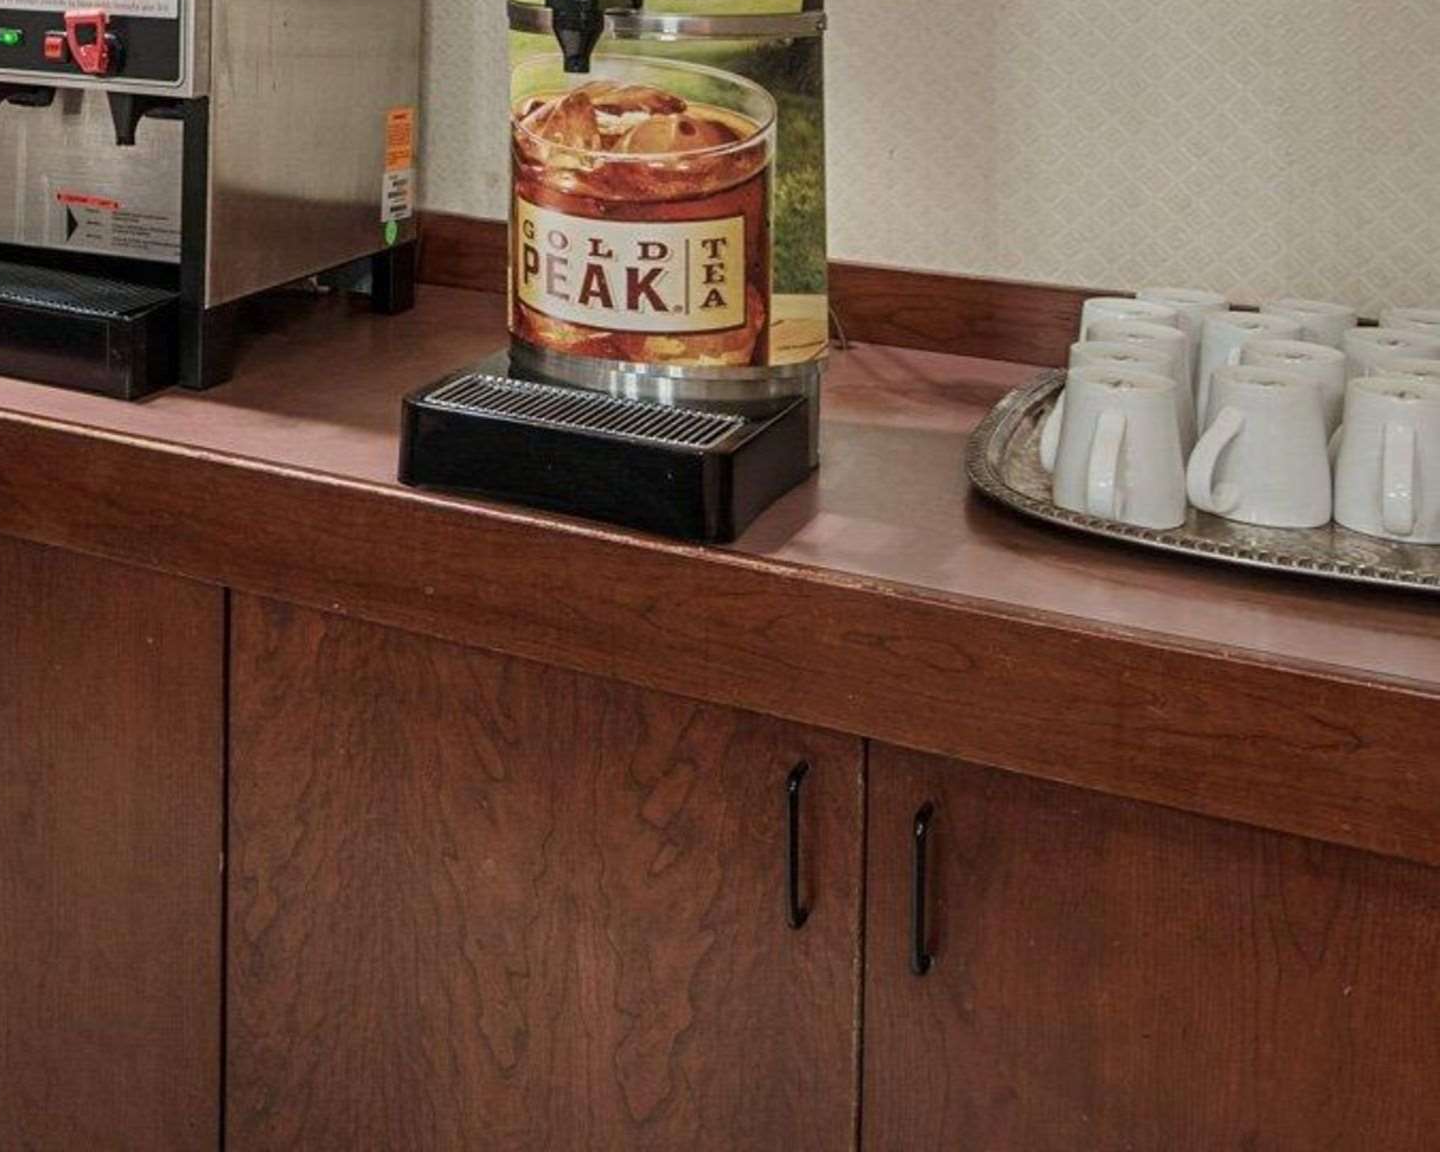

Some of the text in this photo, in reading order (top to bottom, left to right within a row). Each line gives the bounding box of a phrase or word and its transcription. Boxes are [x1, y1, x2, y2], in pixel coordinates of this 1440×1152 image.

[522, 219, 669, 261] GOLD
[700, 237, 728, 309] TEA
[523, 243, 670, 313] PEAK
